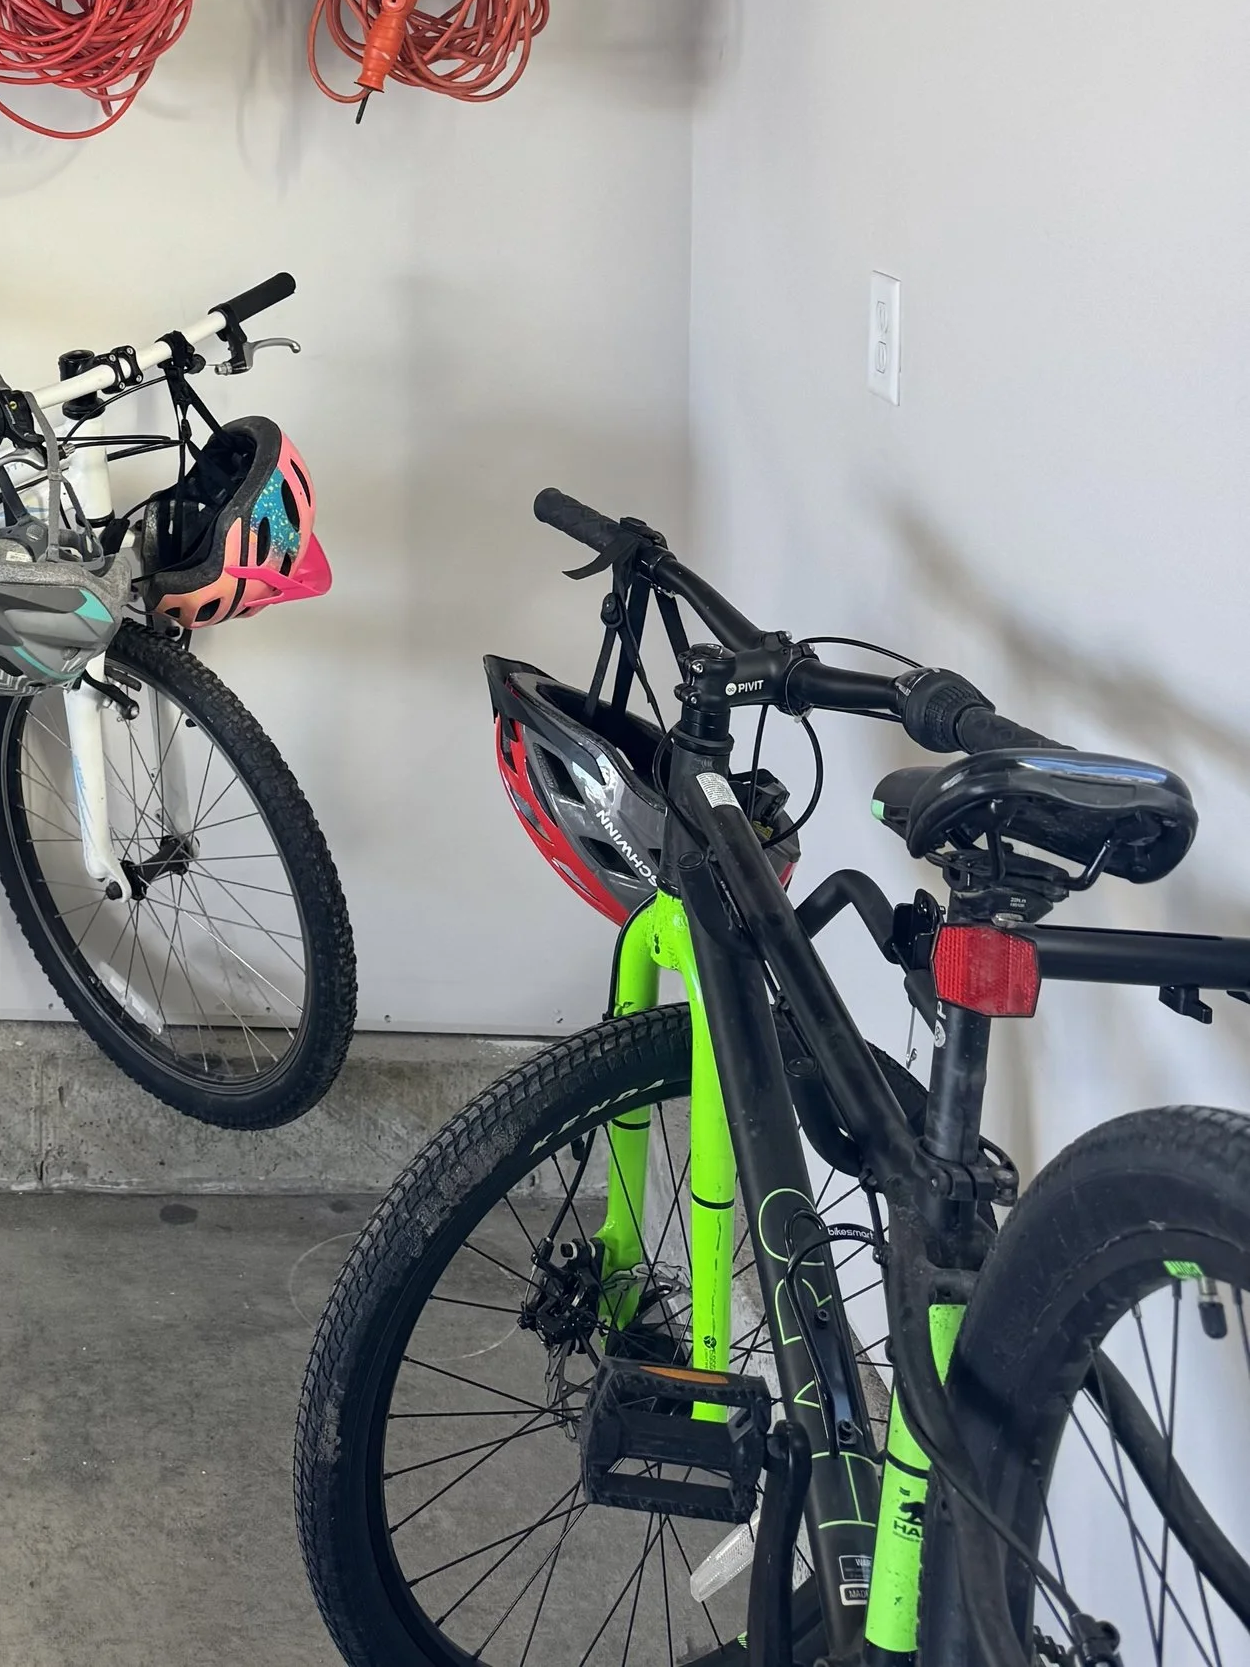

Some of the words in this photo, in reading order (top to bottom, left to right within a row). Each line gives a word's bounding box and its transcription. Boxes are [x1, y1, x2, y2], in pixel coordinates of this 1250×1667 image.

[737, 679, 764, 693] PIVIT
[595, 810, 658, 887] SCHWINN
[529, 1078, 665, 1156] KENDA
[827, 1227, 874, 1240] bikesmart
[893, 1520, 921, 1538] HA
